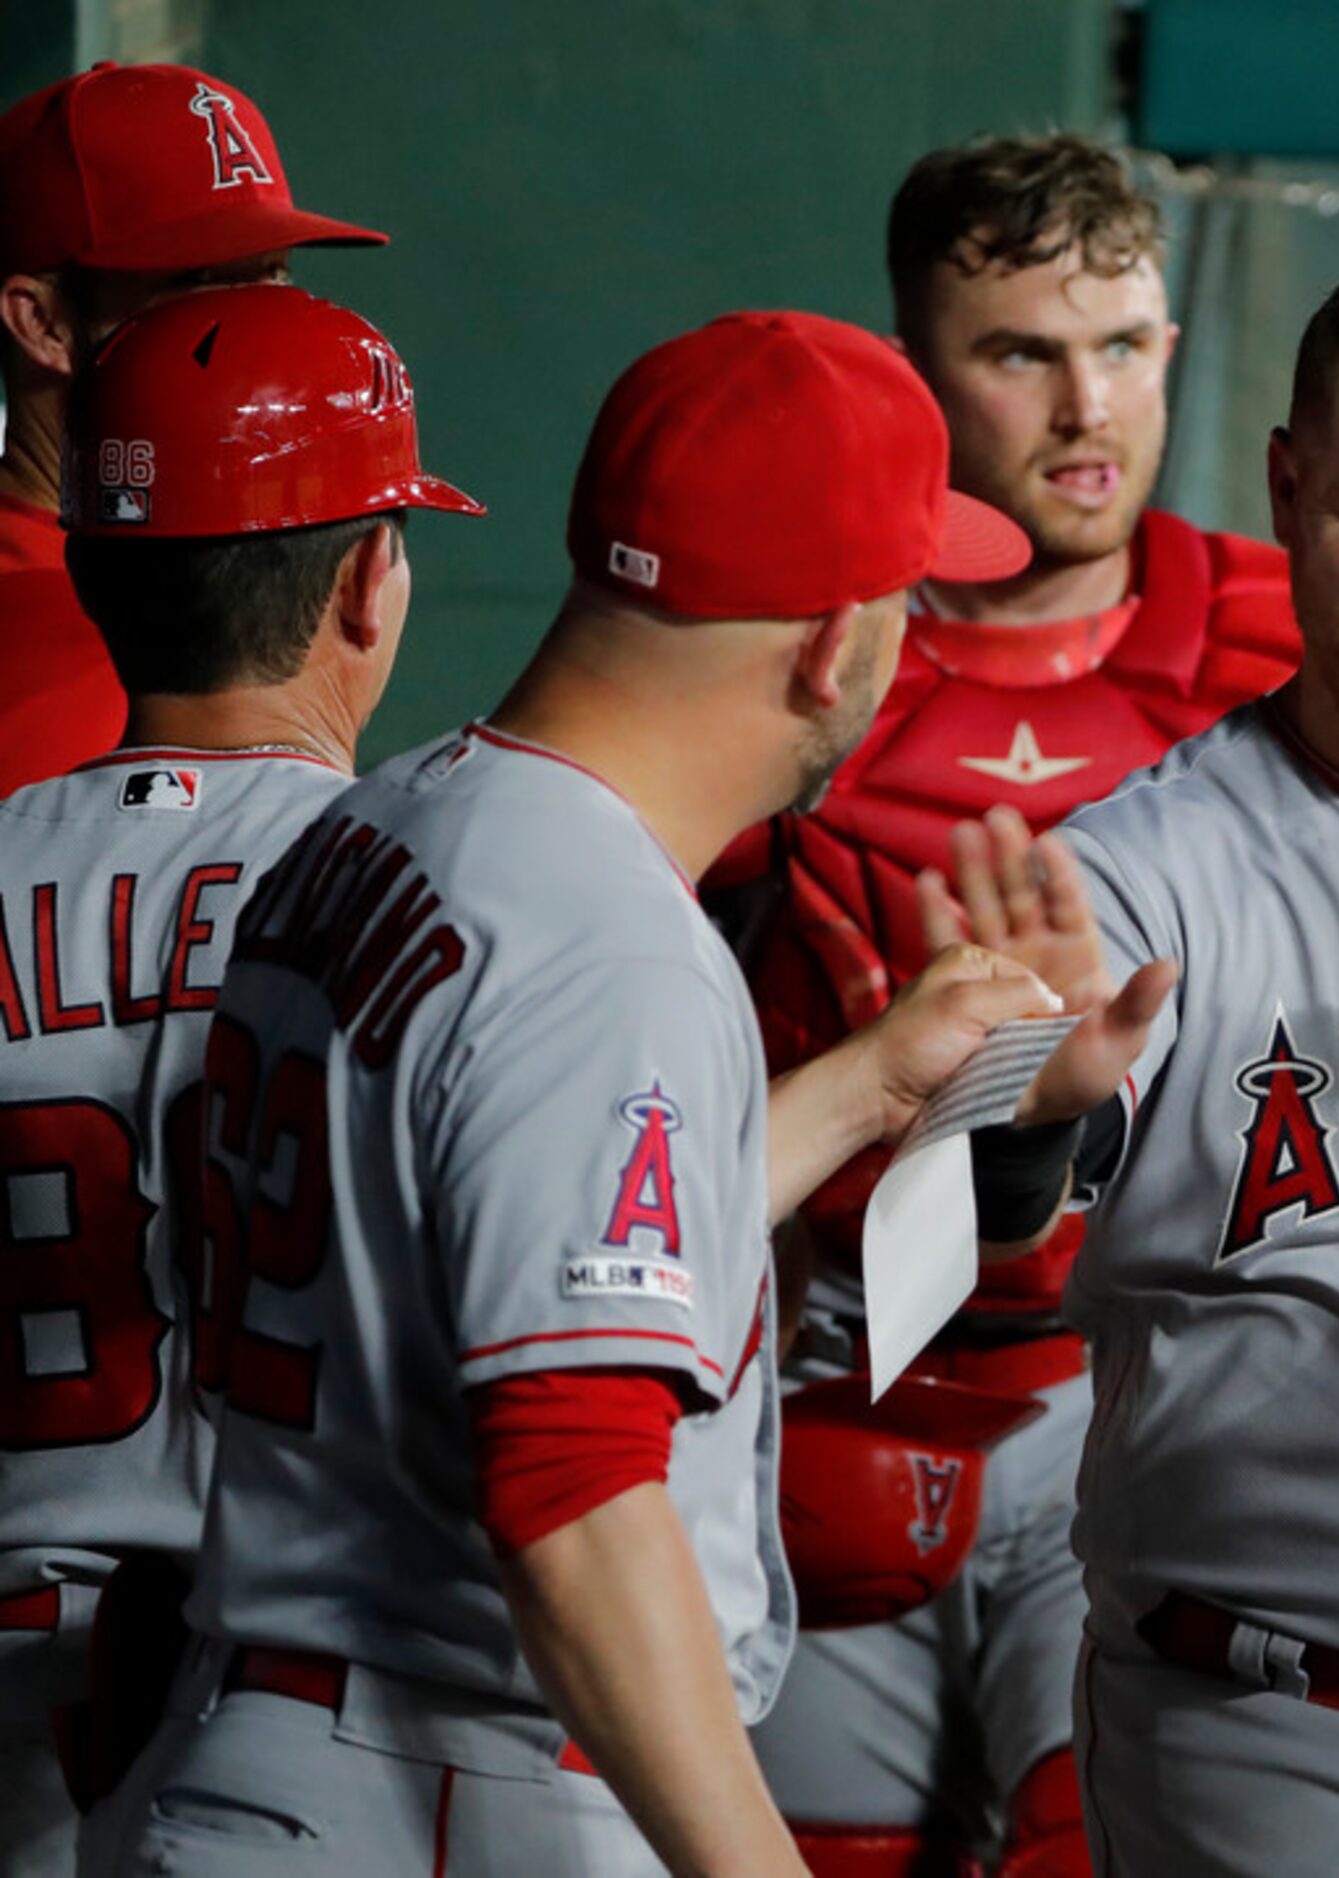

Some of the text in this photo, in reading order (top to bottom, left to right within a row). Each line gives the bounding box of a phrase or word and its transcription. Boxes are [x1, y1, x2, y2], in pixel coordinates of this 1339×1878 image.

[189, 82, 274, 188] A
[99, 439, 156, 487] 86
[599, 1078, 684, 1259] A
[566, 1264, 627, 1290] MLB
[903, 1449, 964, 1558] A
